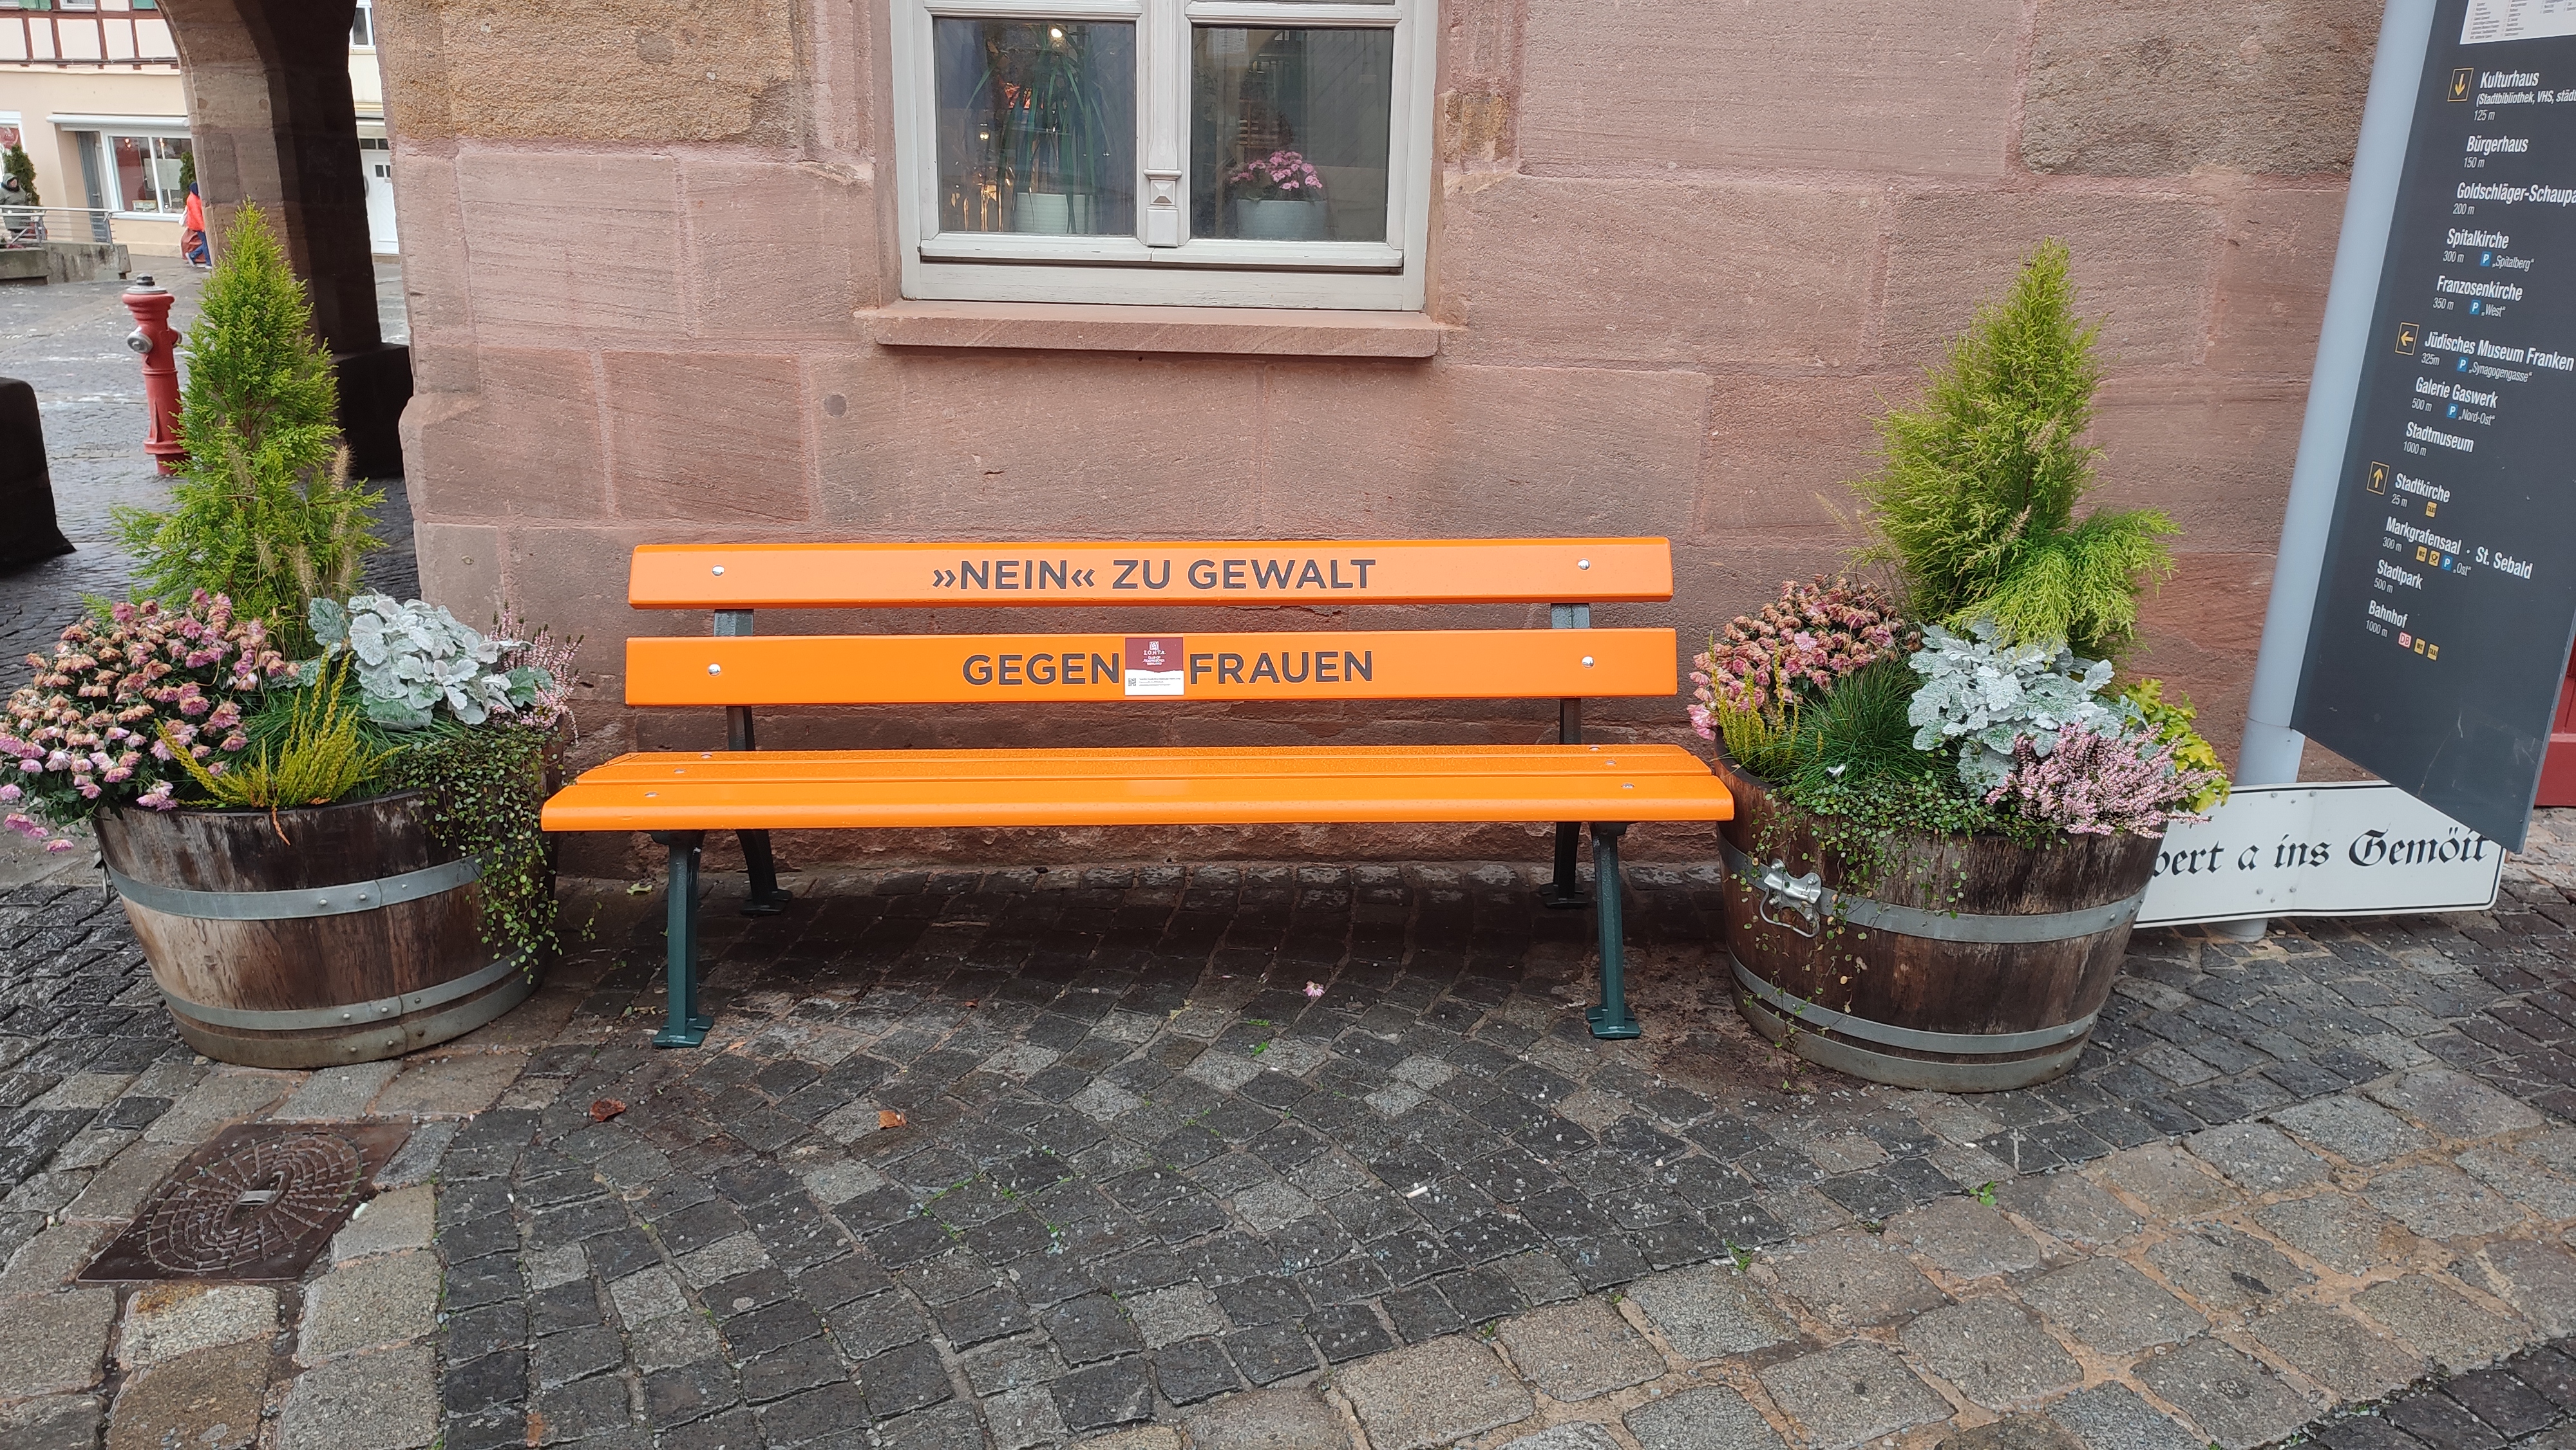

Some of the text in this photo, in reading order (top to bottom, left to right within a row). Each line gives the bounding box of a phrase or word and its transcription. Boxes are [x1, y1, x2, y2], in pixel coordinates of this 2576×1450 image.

[2479, 70, 2540, 89] Kulturhaus
[2476, 91, 2535, 108] (Stadtbibliothek,
[2537, 90, 2554, 104] VHS,
[2474, 109, 2496, 121] 125 m
[2466, 135, 2529, 156] Bürgerhaus
[2463, 156, 2485, 168] 150 m
[2452, 203, 2476, 215] 200 m
[2447, 228, 2510, 249] Spitalkirche
[2443, 250, 2457, 263] 300
[2457, 254, 2465, 263] m
[2436, 275, 2523, 301] Franzosenkirche
[2433, 297, 2447, 310] 350
[2447, 301, 2454, 310] m
[2425, 330, 2575, 372] Jüdisches Museum Franken
[2416, 376, 2499, 409] Galerie Gaswerk
[2411, 397, 2425, 411] 500
[2425, 402, 2432, 412] m
[2405, 421, 2475, 453] Stadtmuseum
[2403, 440, 2427, 457] 1000 m
[2395, 473, 2450, 503] Stadtkirche
[2391, 493, 2401, 505] 25
[2400, 498, 2409, 507] m
[2382, 536, 2395, 551] 300
[2395, 543, 2403, 552] m
[2385, 516, 2533, 580] Markgrafensaal St. Sebald
[932, 559, 1376, 590] »NEIN« ZU GEWALT
[2377, 559, 2424, 590] Stadtpark
[2373, 578, 2394, 594] 500 m
[2368, 599, 2409, 628] Bahnhof
[2365, 619, 2382, 635] 1000
[2381, 627, 2389, 637] m
[962, 650, 1372, 686] GEGEN FRAUEN
[2274, 834, 2333, 869] ins
